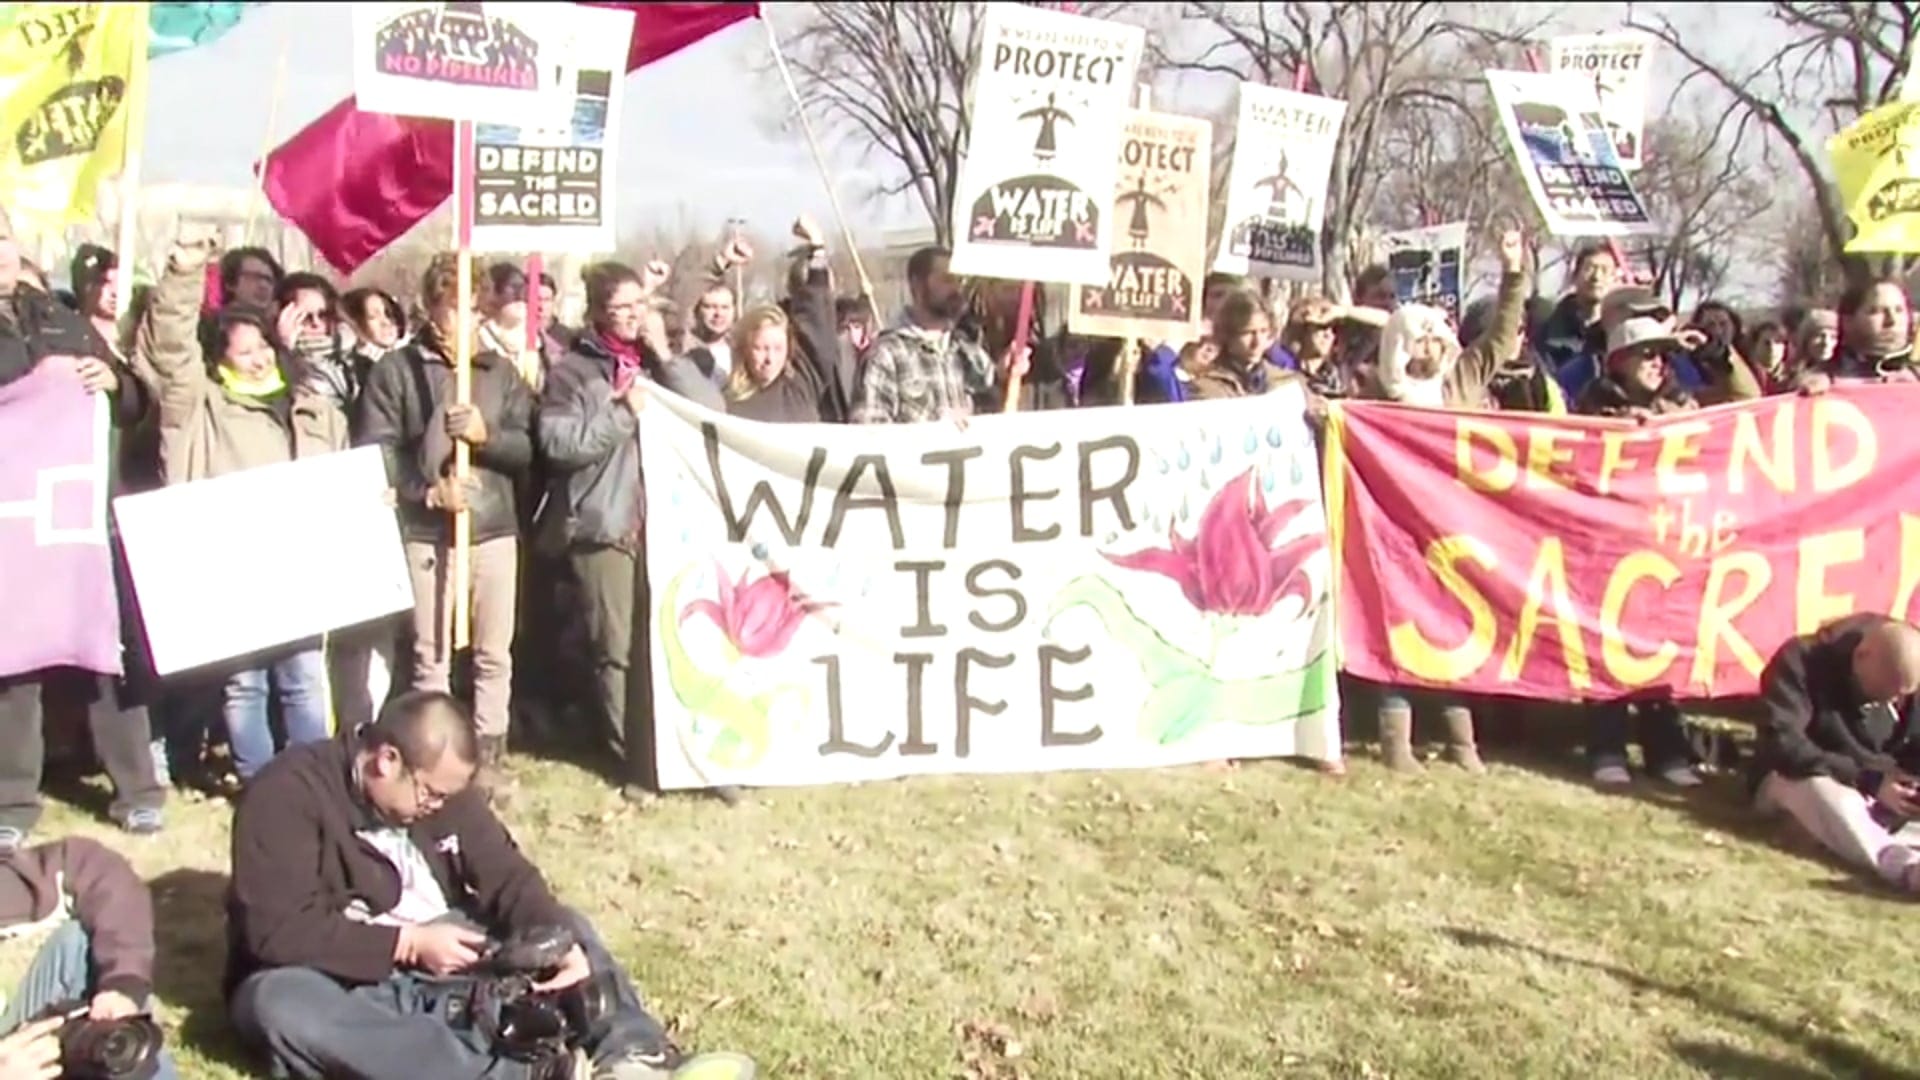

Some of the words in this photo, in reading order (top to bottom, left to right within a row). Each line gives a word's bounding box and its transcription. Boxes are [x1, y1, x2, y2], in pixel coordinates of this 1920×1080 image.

[385, 53, 421, 72] NO
[993, 42, 1124, 85] PROTECT
[1560, 52, 1643, 71] PROTECT
[479, 147, 598, 173] DEFEND
[1118, 138, 1196, 174] OTECT
[523, 174, 557, 190] THE
[479, 192, 597, 217] SACRED
[991, 184, 1089, 222] WATER
[1010, 215, 1027, 234] IS
[1030, 214, 1063, 236] LIFE
[1455, 399, 1879, 496] DEFEND
[702, 422, 1140, 549] WATER
[1650, 498, 1739, 556] the
[894, 560, 1028, 638] IS
[811, 645, 1103, 758] LIFE
